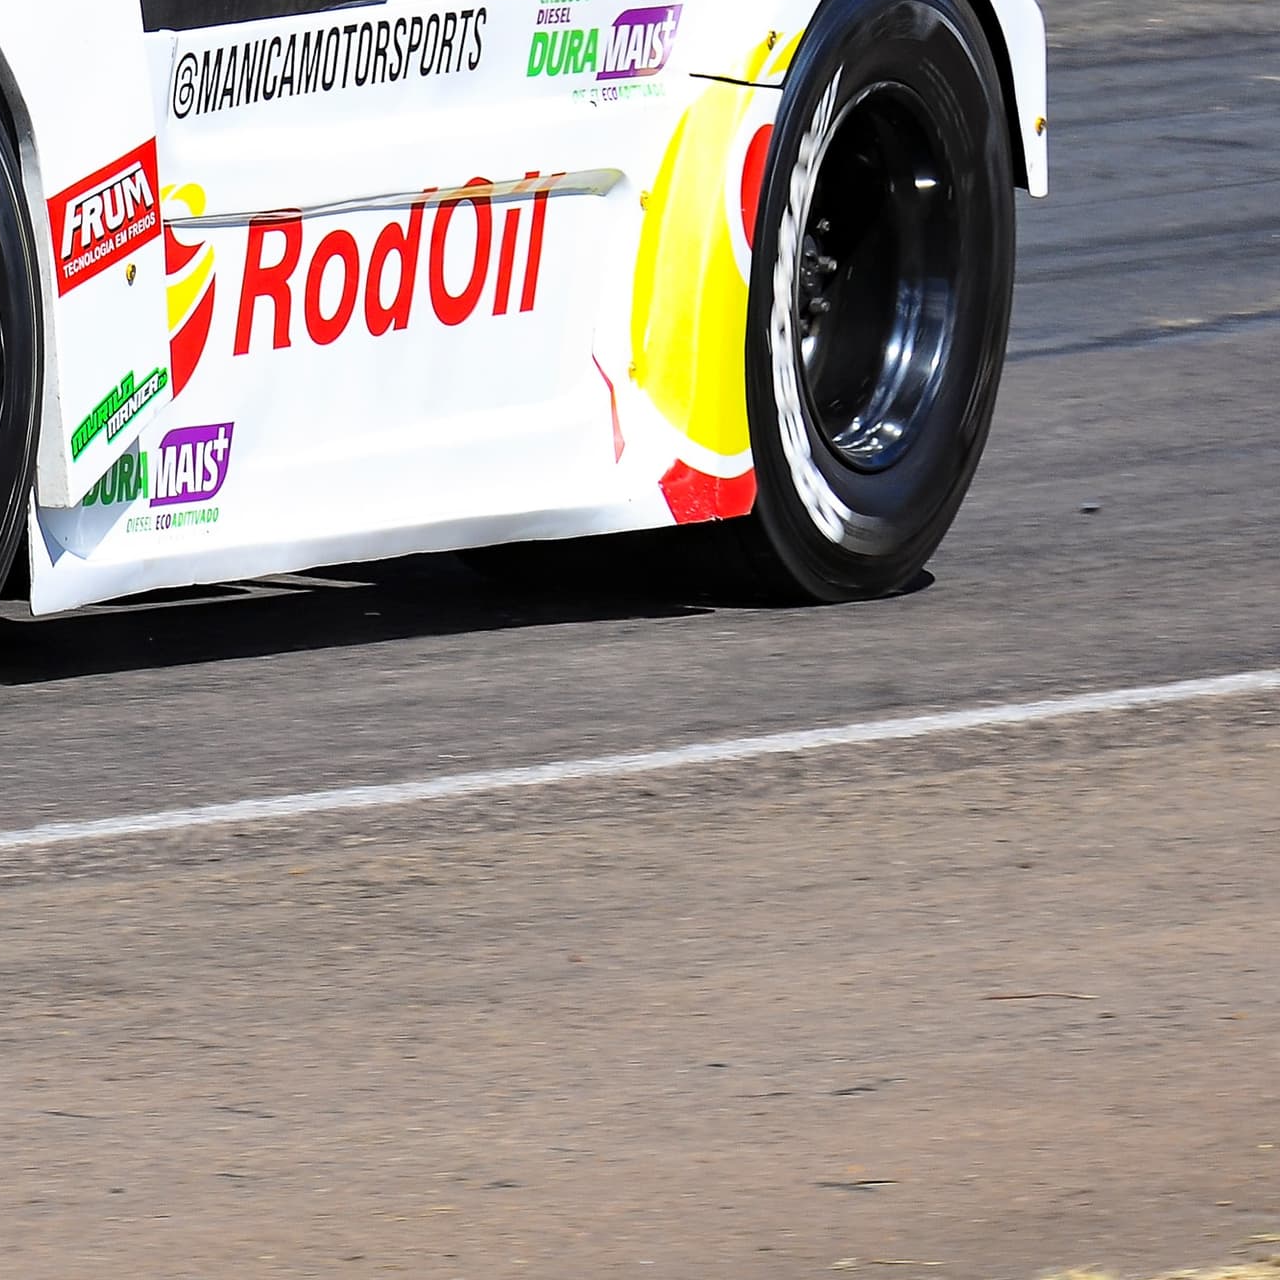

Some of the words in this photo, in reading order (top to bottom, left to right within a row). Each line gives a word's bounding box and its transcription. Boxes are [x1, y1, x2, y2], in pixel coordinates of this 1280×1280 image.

[526, 28, 599, 77] DURA
[536, 7, 571, 25] DIESEL
[173, 7, 487, 119] @MANICAMOTORSPORTS
[60, 161, 155, 261] FRUM
[63, 240, 115, 279] TECNOLOGIA
[114, 231, 128, 248] EM
[128, 211, 156, 240] FREIOS
[233, 170, 567, 357] RodOil
[70, 370, 134, 462] MURILO
[155, 507, 220, 530] ECOADITIVADO
